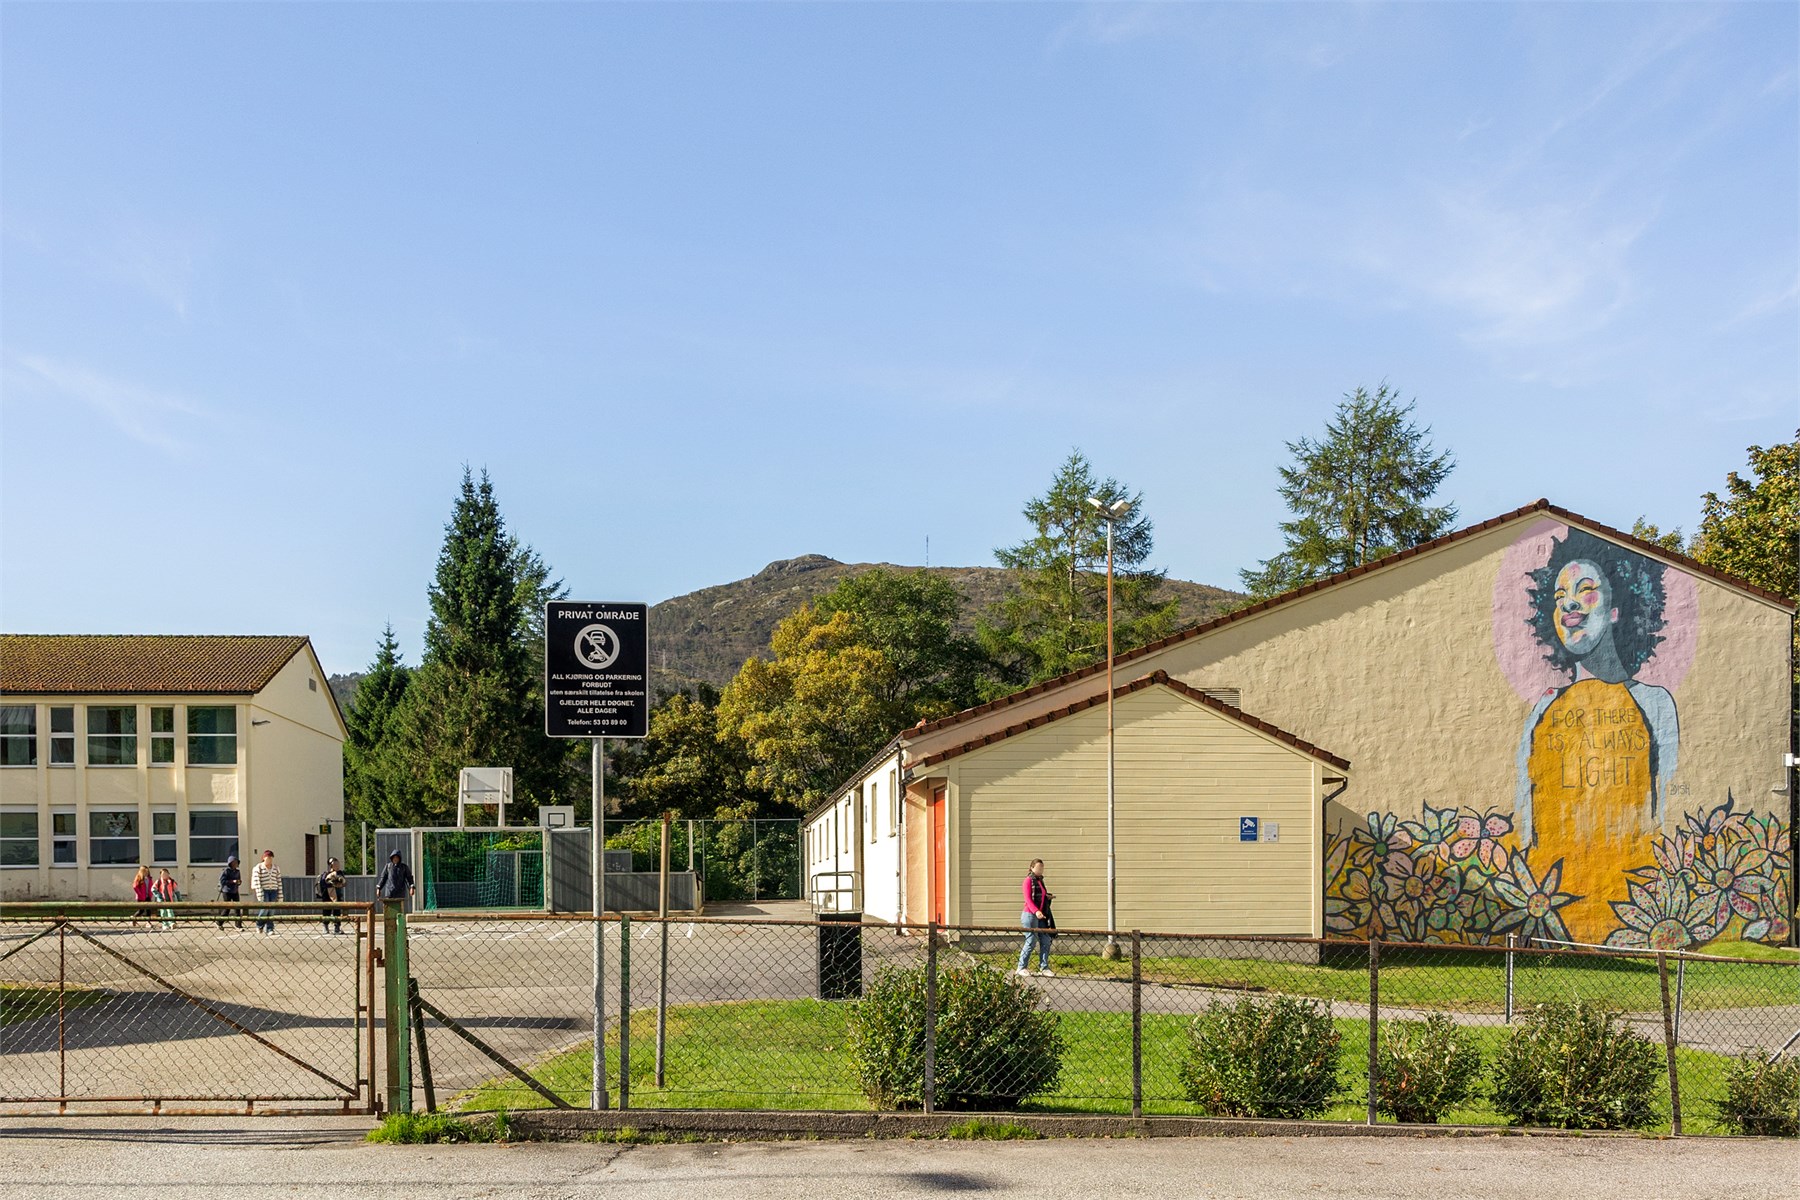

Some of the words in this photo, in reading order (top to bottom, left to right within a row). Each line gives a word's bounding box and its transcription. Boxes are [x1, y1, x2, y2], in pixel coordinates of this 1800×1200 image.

[558, 610, 593, 620] PRIVAT
[596, 610, 640, 620] OMRÅDE
[1552, 709, 1586, 728] FOR
[1594, 708, 1637, 725] THERE
[1548, 734, 1565, 752] IS
[1580, 728, 1646, 752] ALWAYS
[1561, 756, 1636, 788] LIGHT
